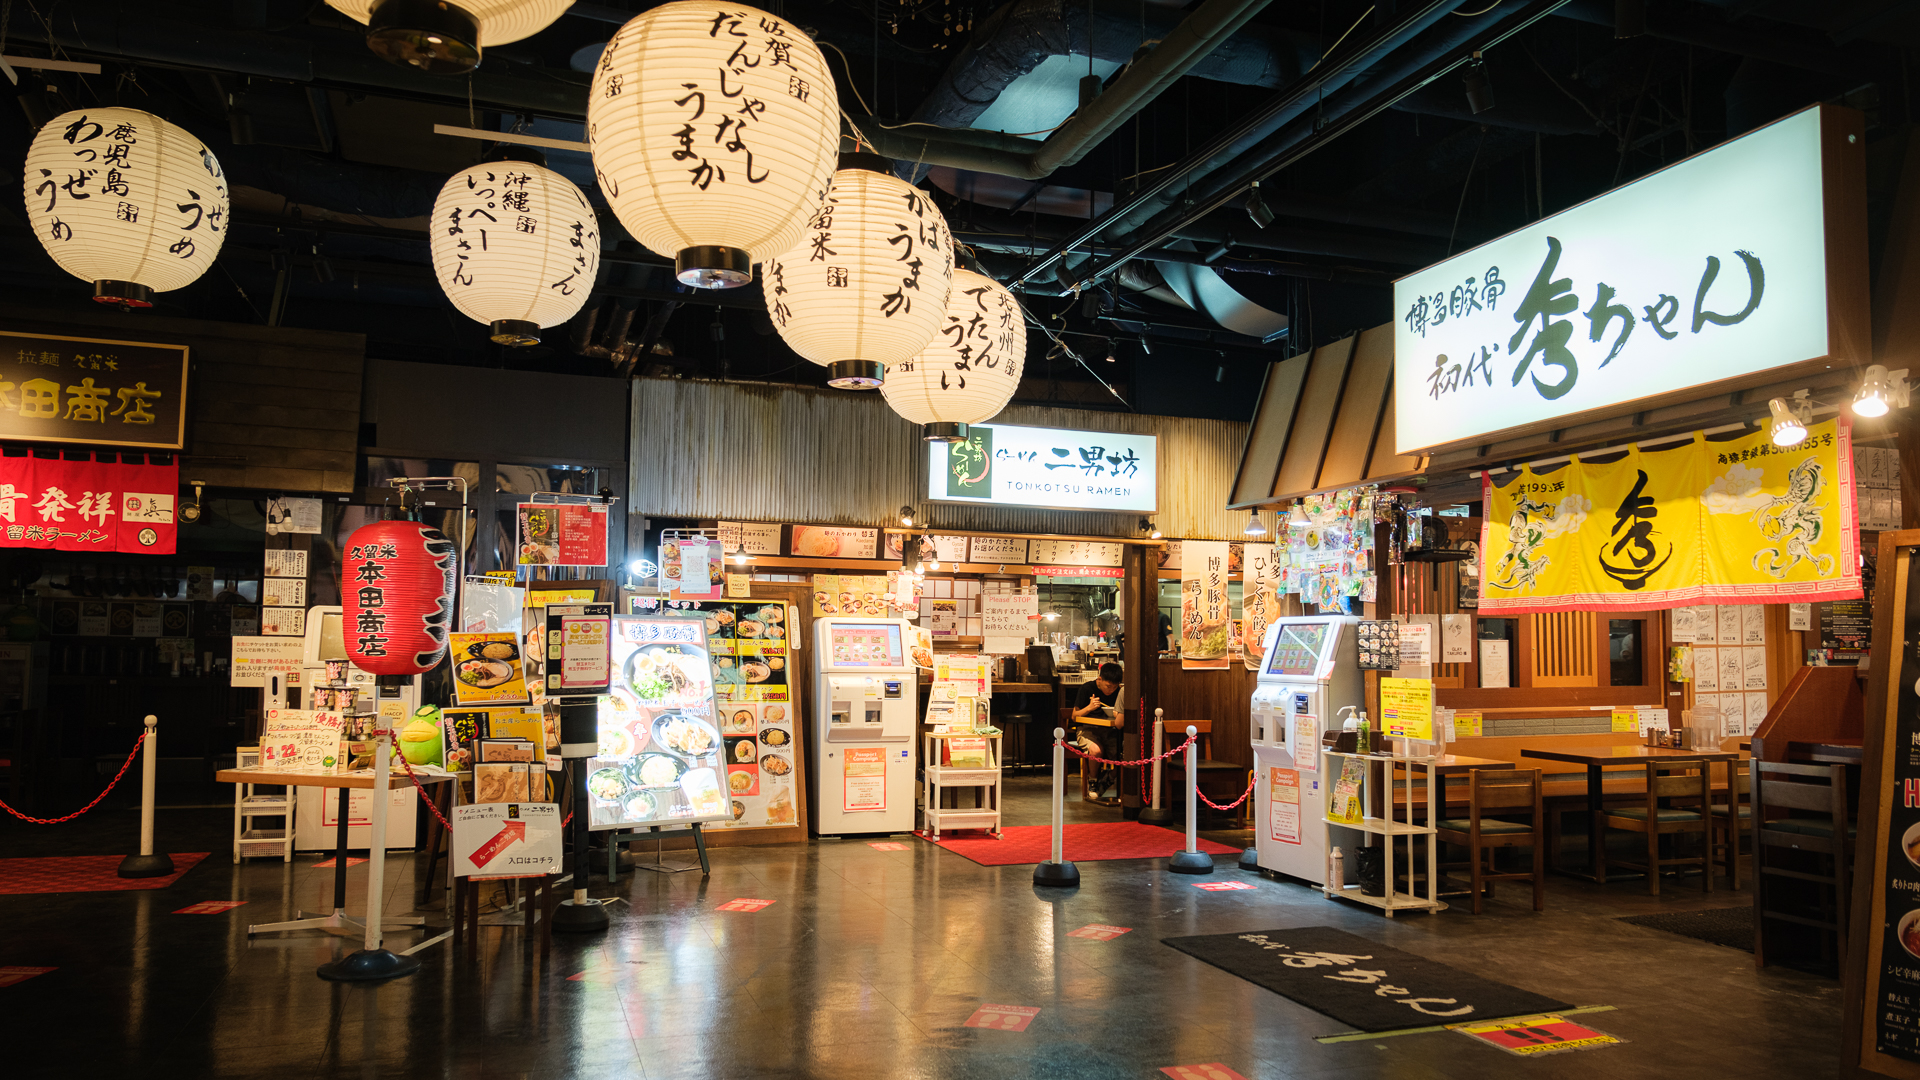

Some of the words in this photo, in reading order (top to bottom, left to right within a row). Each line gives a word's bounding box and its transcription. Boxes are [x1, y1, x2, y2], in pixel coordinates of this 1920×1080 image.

[61, 115, 104, 200] わっぜ
[101, 122, 137, 197] 鹿児島
[671, 83, 726, 191] うまか
[35, 168, 73, 242] うめ
[169, 188, 204, 259] うめ
[502, 171, 532, 213] 沖縄
[448, 207, 473, 287] まさん
[551, 220, 587, 296] まさん
[880, 223, 924, 318] うまか
[962, 284, 1000, 369] でたん
[997, 293, 1015, 356] 北九州
[1404, 264, 1506, 339] 博多豚骨
[1507, 235, 1766, 401] 秀ちゃん
[941, 316, 974, 391] うまい
[1426, 342, 1500, 401] 初代
[1007, 480, 1080, 494] TONKOTSU
[1087, 485, 1131, 496] RAMEN
[1044, 446, 1140, 480] 二男坊
[0, 524, 109, 544] 留米ラーメン
[1612, 468, 1659, 569] 秀
[350, 543, 399, 561] 久留米
[354, 559, 390, 657] 本田商店
[668, 600, 702, 610] セット
[984, 607, 1030, 615] ご案内するまで、
[1189, 580, 1204, 640] らーめん
[1207, 556, 1221, 620] 博多豚骨
[1252, 556, 1267, 647] ひとくち餃子
[629, 623, 698, 643] 博多豚骨
[984, 623, 1030, 631] お待ちください。
[479, 829, 516, 861] らーめん二男坊
[508, 856, 554, 865] 入口はコチラ
[1885, 1012, 1911, 1025] 煮玉子
[1888, 992, 1911, 1005] 替え玉
